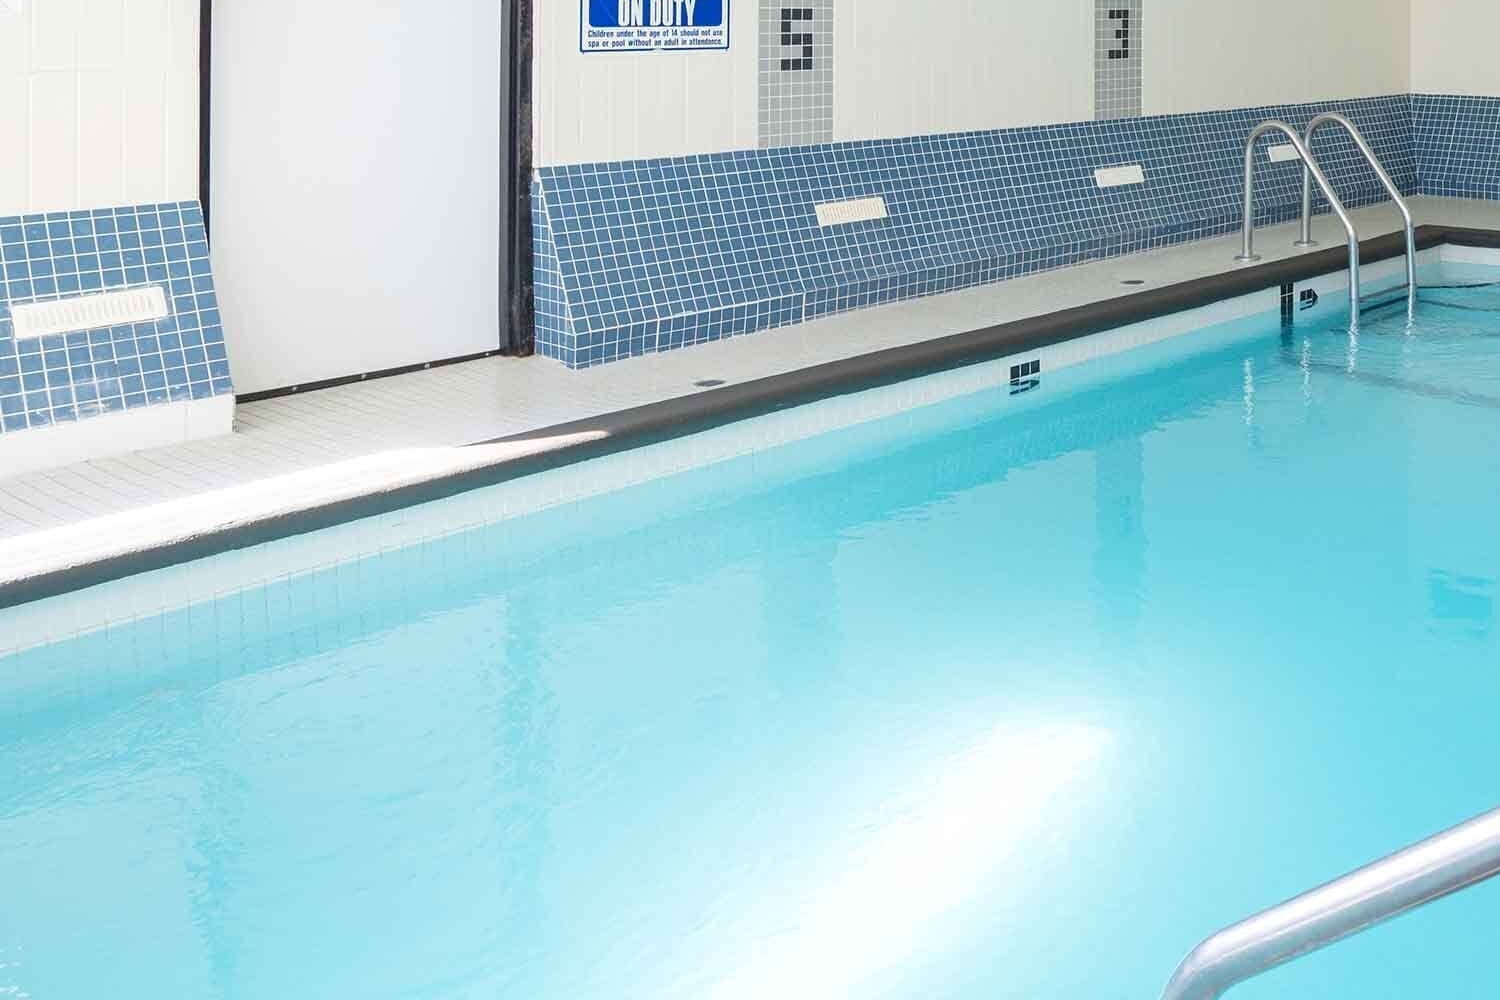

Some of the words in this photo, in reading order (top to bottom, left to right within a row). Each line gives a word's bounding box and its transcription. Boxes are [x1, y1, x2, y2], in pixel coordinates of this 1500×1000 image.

[588, 30, 614, 38] Children
[637, 29, 647, 37] the
[649, 31, 660, 39] age
[612, 40, 625, 48] pool
[628, 39, 651, 47] without
[664, 38, 678, 46] adult
[780, 8, 813, 71] 5
